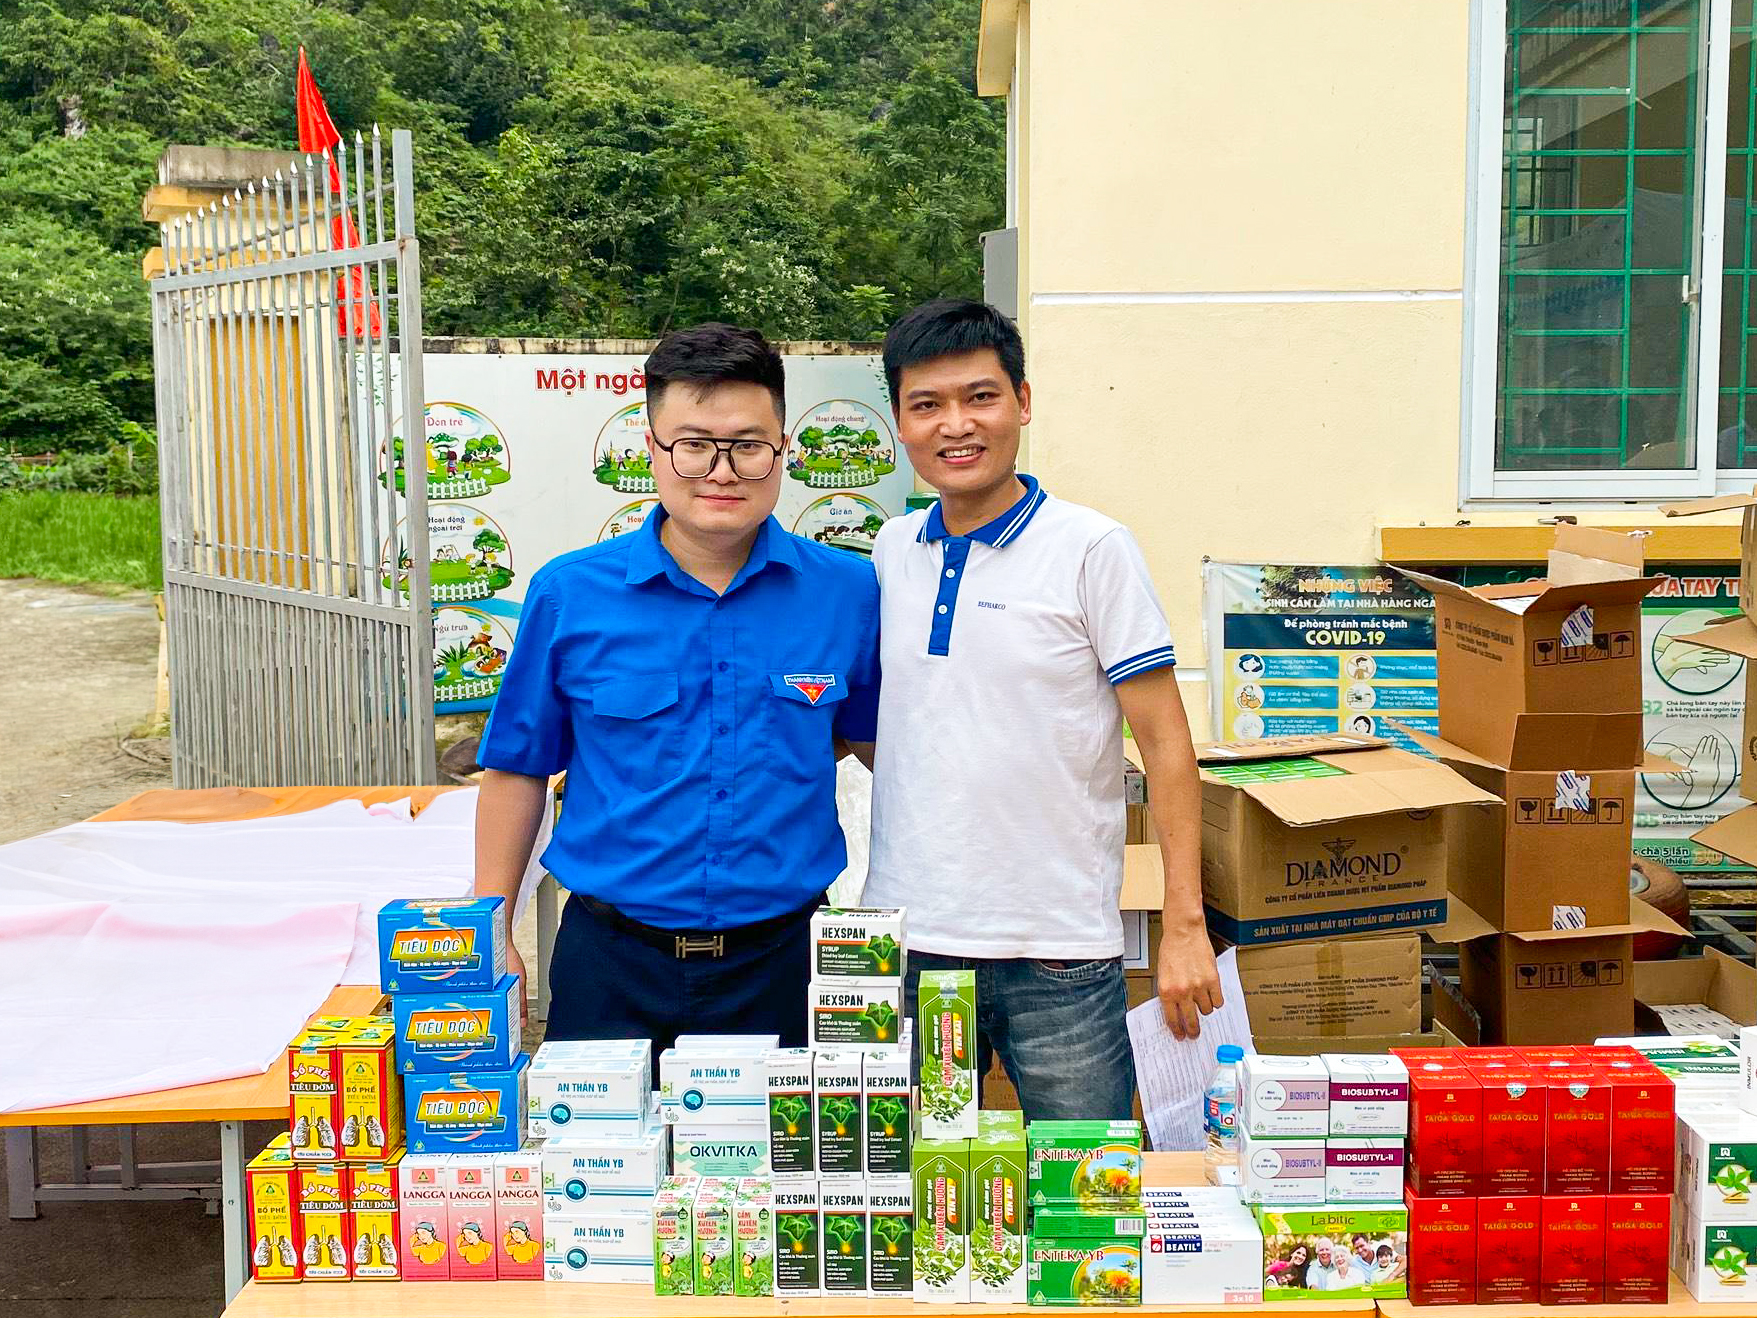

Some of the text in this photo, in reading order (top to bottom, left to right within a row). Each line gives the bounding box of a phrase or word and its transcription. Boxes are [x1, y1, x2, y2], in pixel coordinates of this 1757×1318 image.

[537, 365, 647, 396] Một ngà
[1357, 575, 1393, 596] VIỆC
[1681, 577, 1722, 597] TAY
[1267, 598, 1288, 608] SINH
[1313, 596, 1336, 608] LÀM
[1338, 598, 1355, 610] TẠI
[1357, 596, 1379, 608] NHÀ
[1381, 596, 1412, 608] HÀNG
[1414, 596, 1436, 608] NGÀ
[1299, 619, 1331, 630] phòng
[1332, 618, 1359, 628] tránh
[1360, 617, 1380, 628] mắc
[1382, 618, 1408, 630] bệnh
[1305, 630, 1386, 646] COVID-19
[1662, 847, 1670, 856] 5
[1285, 852, 1402, 887] DIAMOND
[1305, 874, 1379, 889] FRANCE
[822, 927, 866, 939] HEXSPAN
[400, 936, 428, 954] TIÊU
[819, 994, 864, 1006] HEXSPAN
[415, 1018, 445, 1035] TIÊU
[690, 1068, 702, 1078] AN
[729, 1068, 741, 1078] YB
[557, 1083, 570, 1092] AN
[597, 1083, 609, 1092] YB
[768, 1076, 809, 1087] HEXSPAN
[818, 1077, 859, 1087] HEXSPAN
[867, 1077, 907, 1087] HEXSPAN
[1341, 1088, 1399, 1096] BIOSUBTYL-II
[425, 1098, 453, 1116] TIÊU
[690, 1145, 758, 1158] OKVITKA
[1034, 1148, 1104, 1161] ENTEKA YB
[1337, 1153, 1394, 1162] BIOSUBTYL-II
[573, 1158, 585, 1168] AN
[613, 1158, 624, 1168] YB
[403, 1190, 446, 1200] LANGGA
[449, 1191, 492, 1200] LANGGA
[497, 1189, 539, 1199] LANGGA
[775, 1194, 816, 1205] HEXSPAN
[823, 1195, 864, 1206] HEXSPAN
[870, 1196, 911, 1207] HEXSPAN
[1312, 1214, 1355, 1226] Labitic
[573, 1227, 586, 1237] AN
[614, 1228, 625, 1238] YB
[1034, 1249, 1104, 1262] ENTEKA YB
